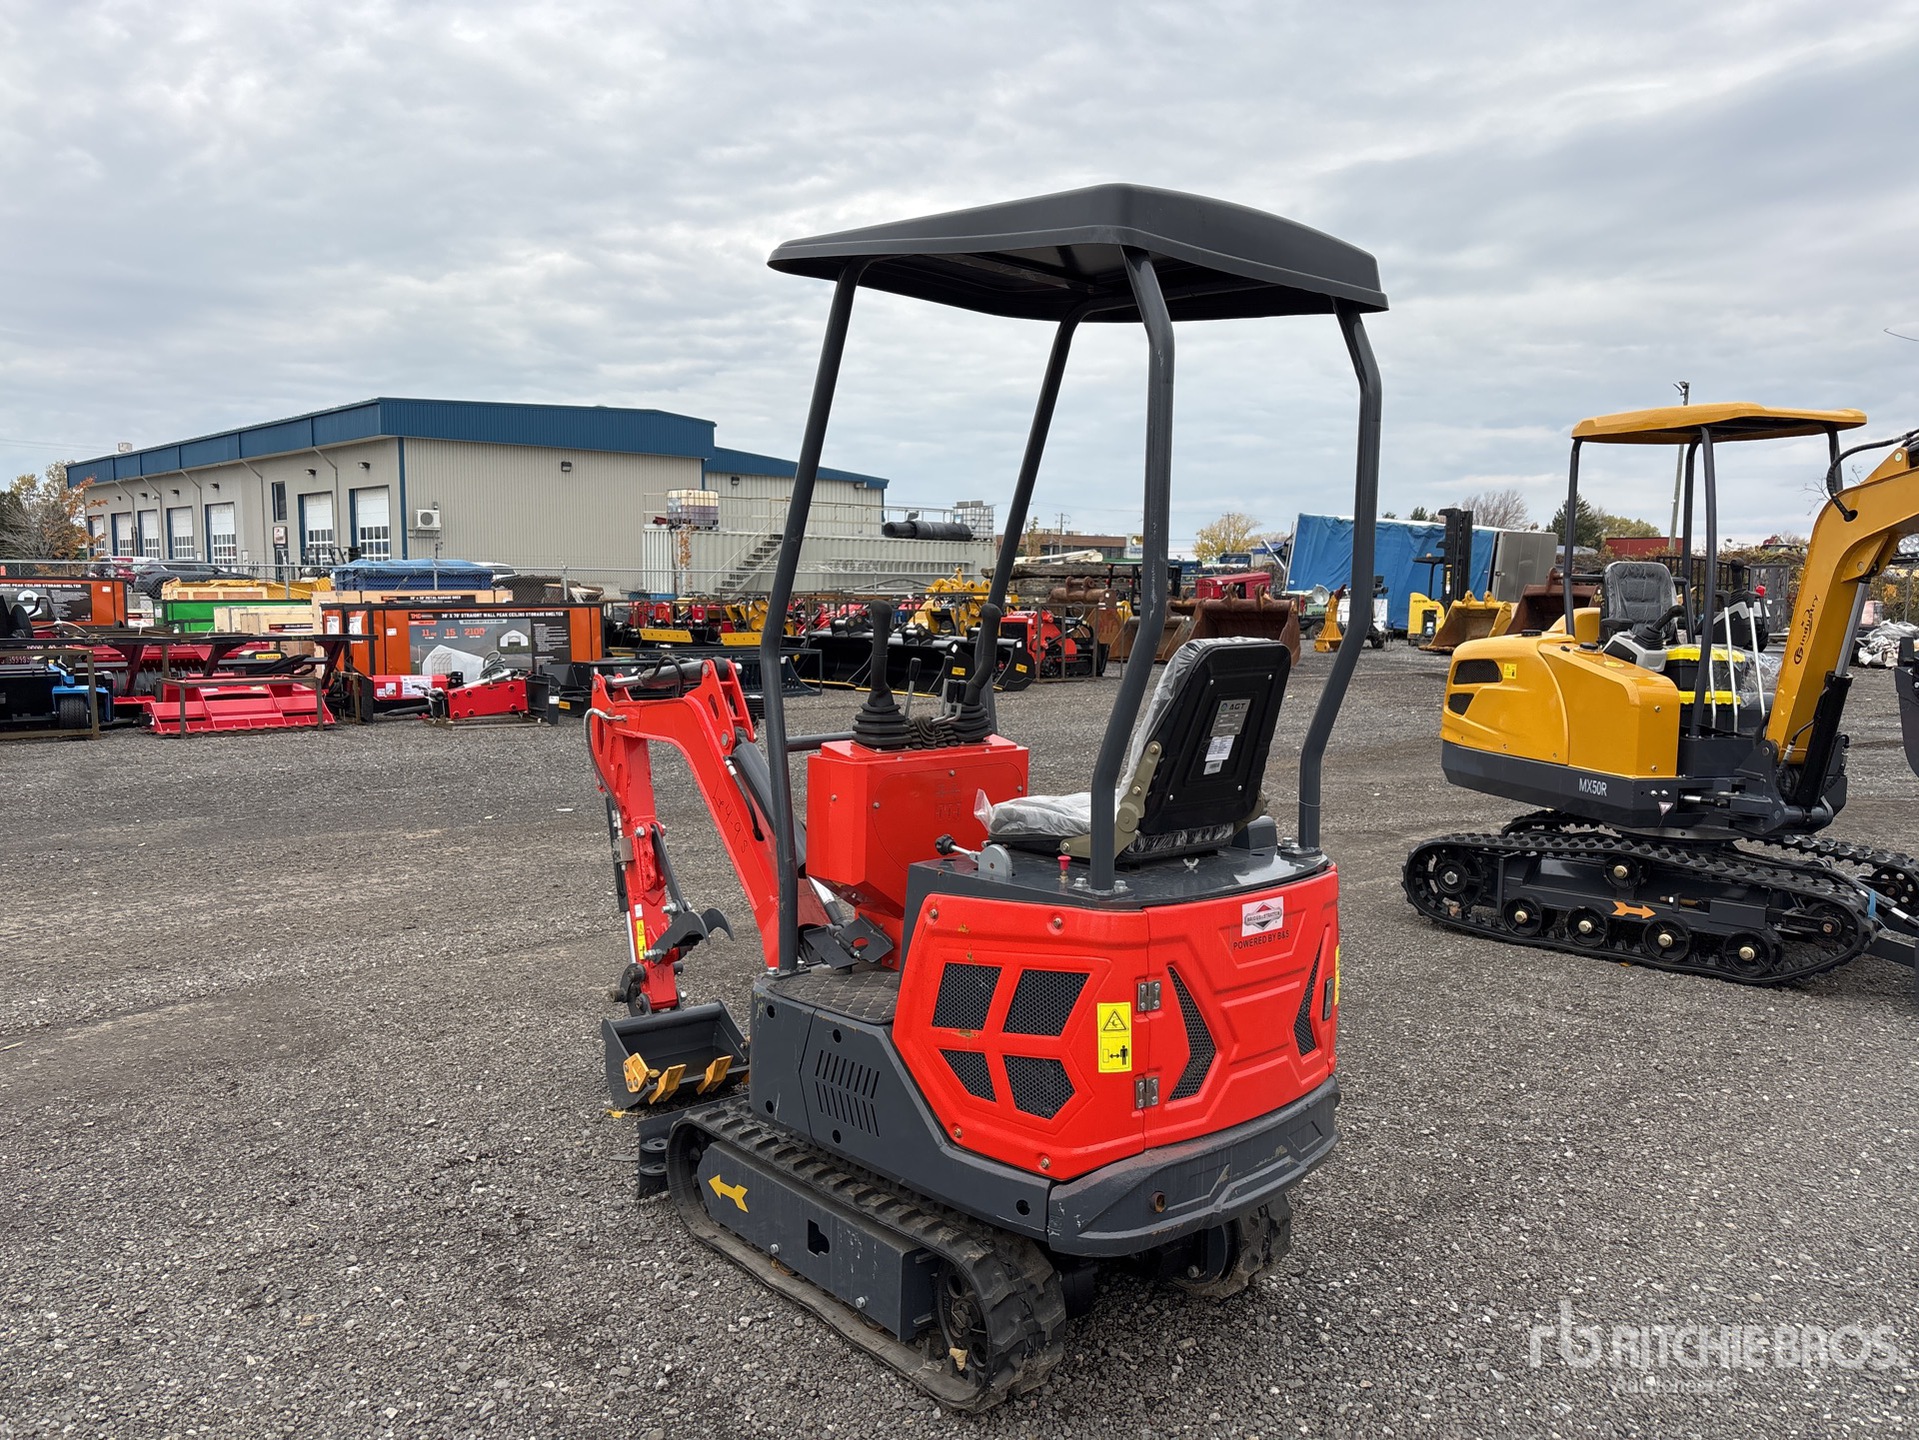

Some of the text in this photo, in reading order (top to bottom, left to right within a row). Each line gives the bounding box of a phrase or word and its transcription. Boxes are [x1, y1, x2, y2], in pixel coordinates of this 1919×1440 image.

[464, 627, 485, 636] 2100
[1229, 702, 1246, 710] AGT
[1578, 777, 1607, 797] MX50R
[1233, 930, 1289, 950] POWERED BY B&S
